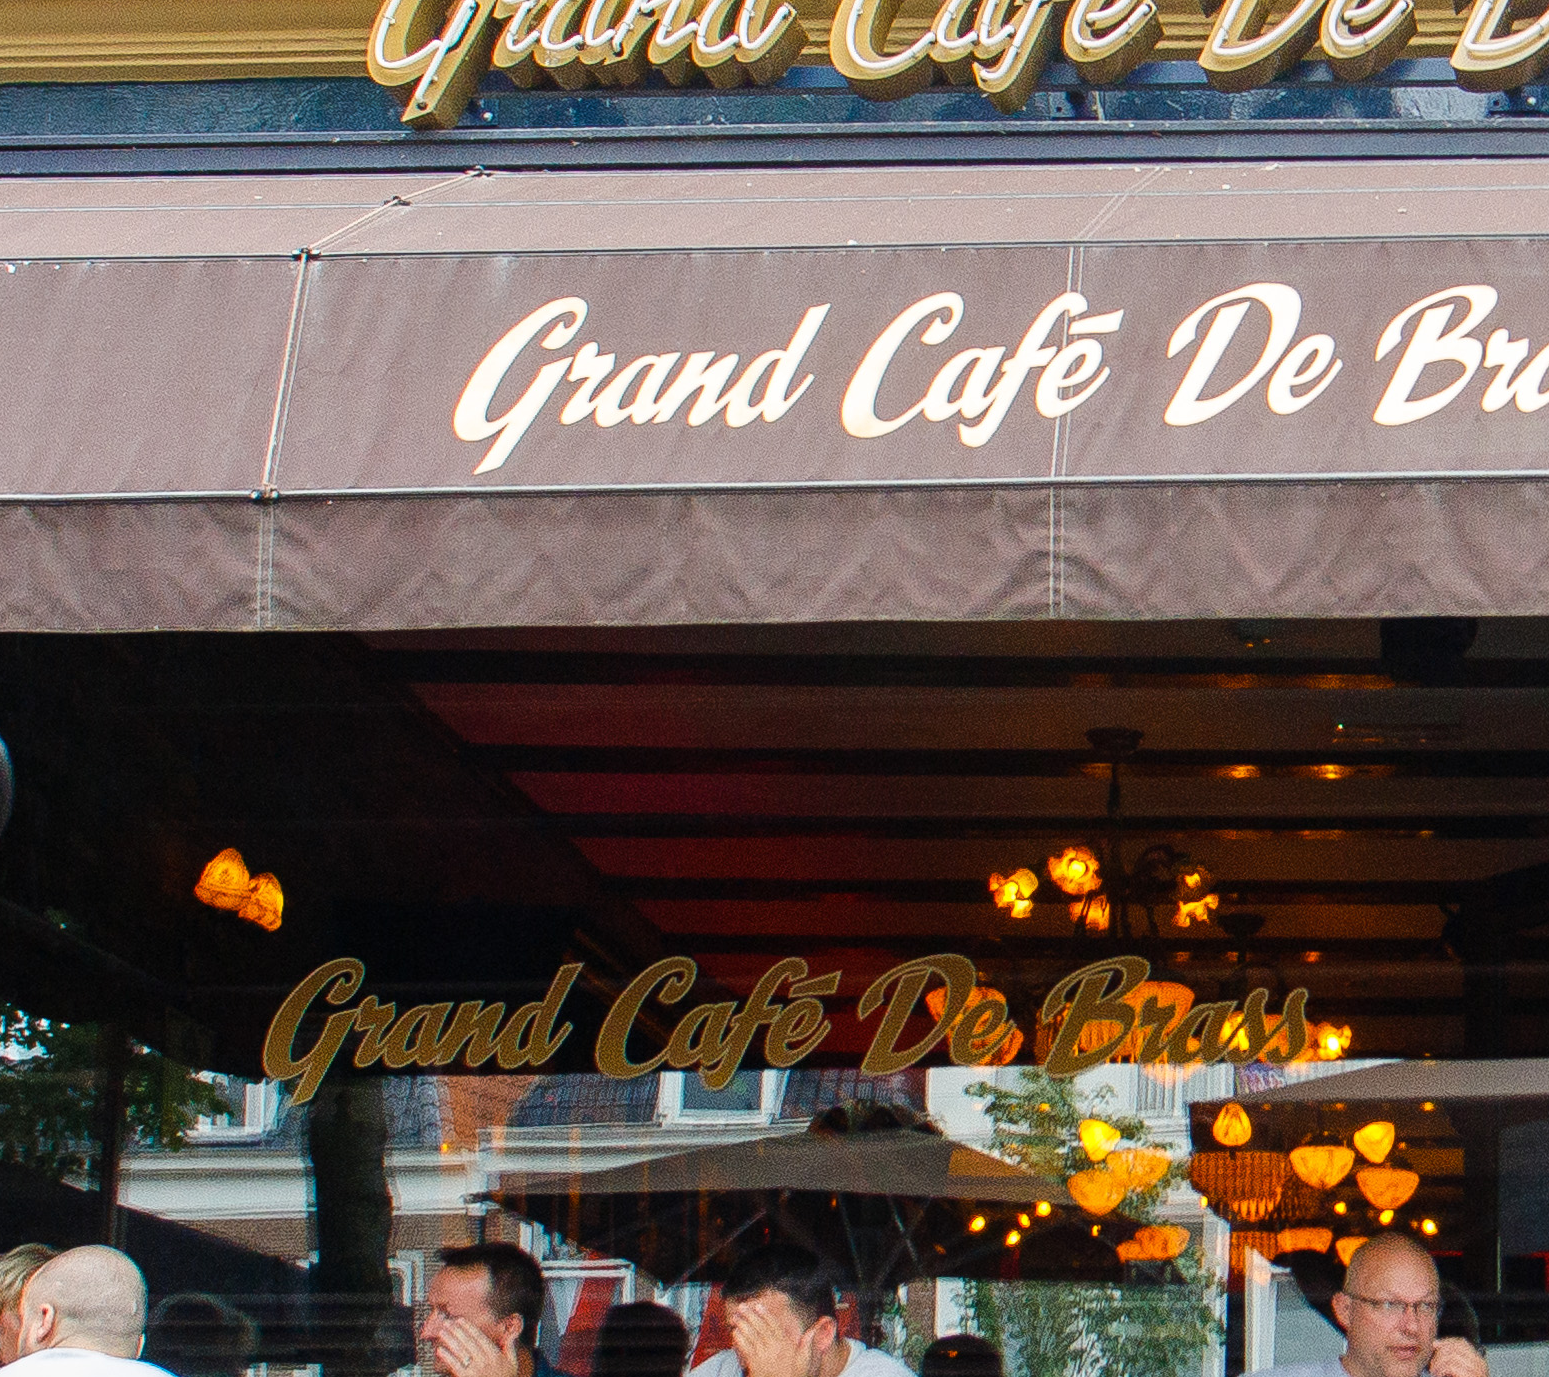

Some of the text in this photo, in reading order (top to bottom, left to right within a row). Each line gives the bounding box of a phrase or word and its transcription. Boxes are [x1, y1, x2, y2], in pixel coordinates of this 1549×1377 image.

[454, 296, 831, 474] Grand
[841, 291, 1126, 448] Café
[1164, 281, 1343, 427] De
[261, 954, 1310, 1105] Grand Café De Brass
